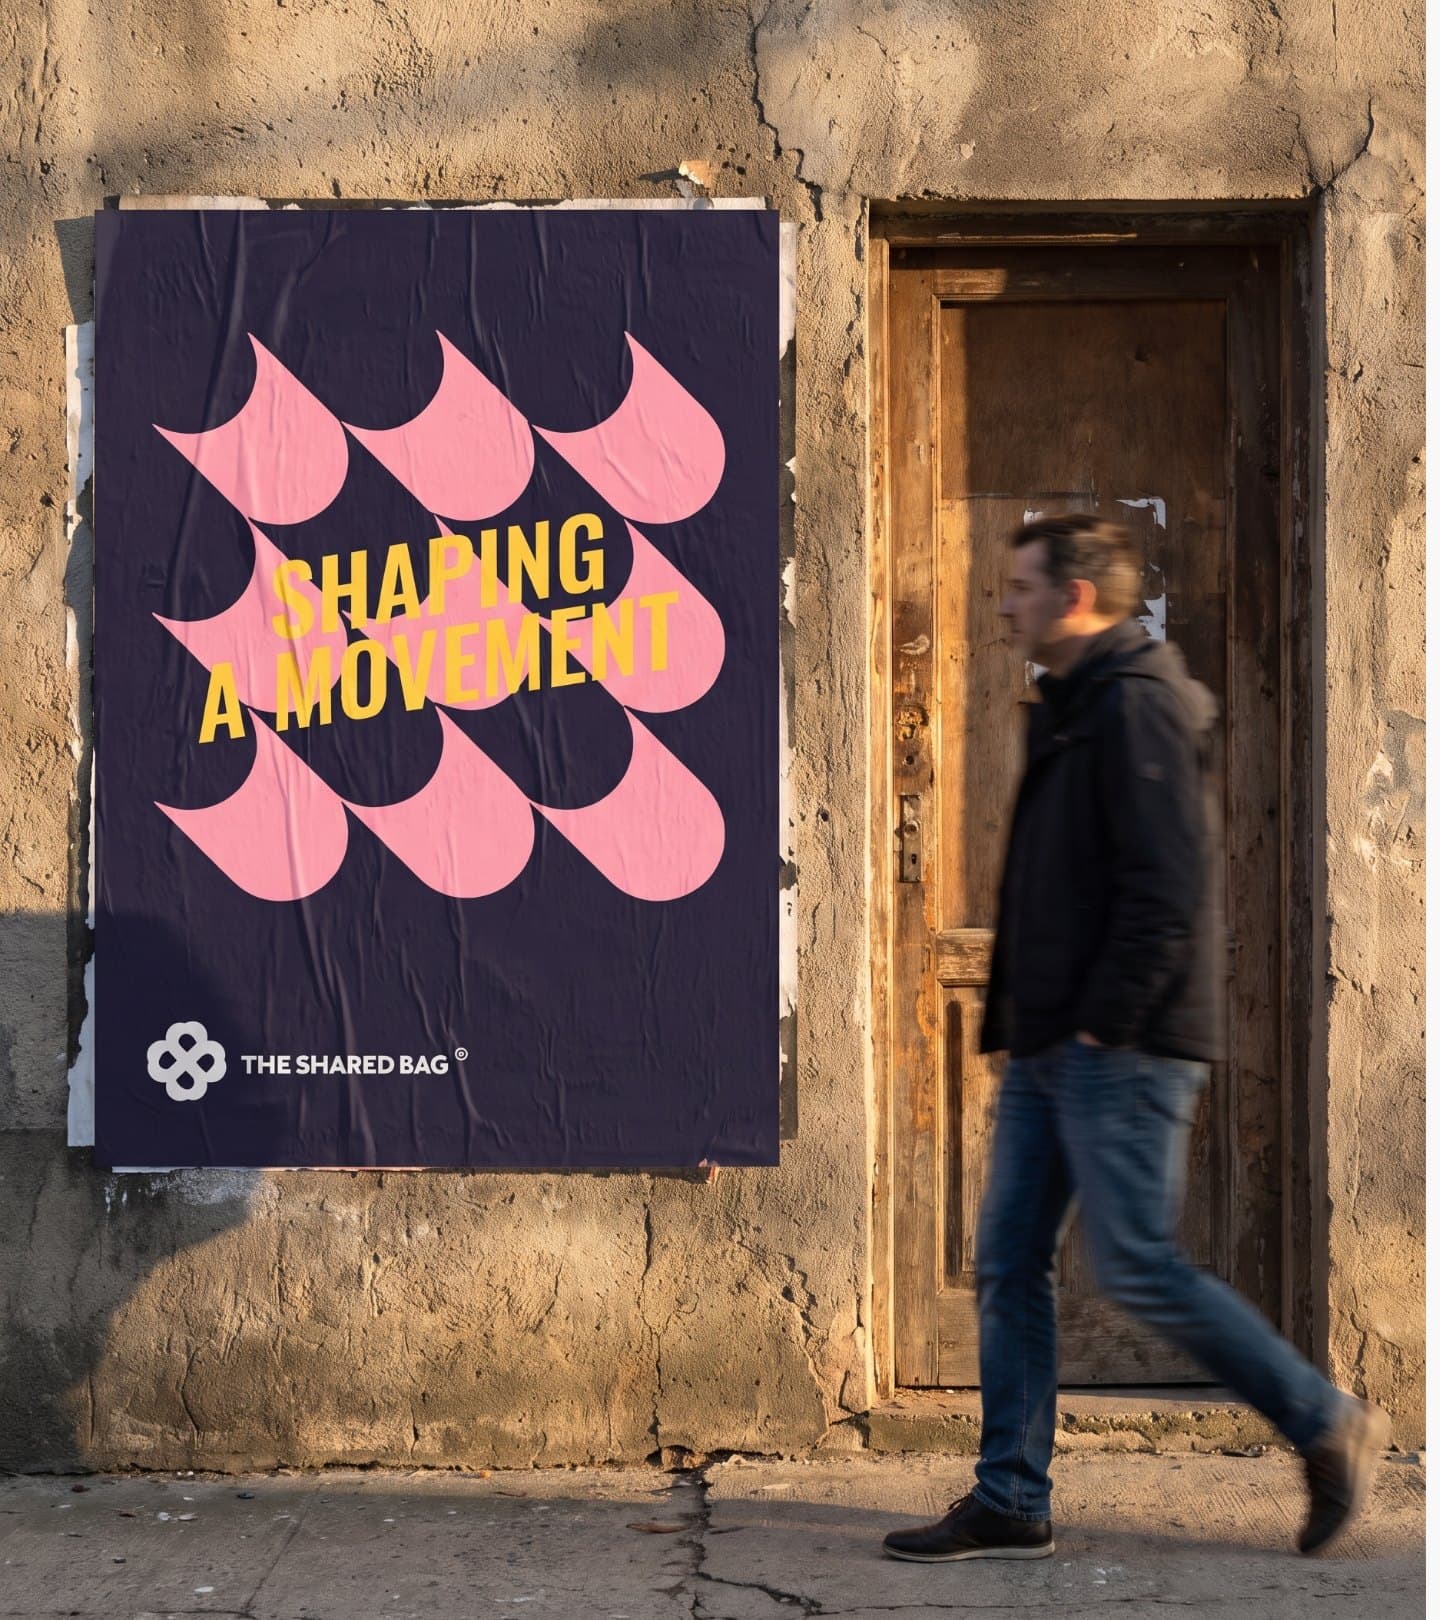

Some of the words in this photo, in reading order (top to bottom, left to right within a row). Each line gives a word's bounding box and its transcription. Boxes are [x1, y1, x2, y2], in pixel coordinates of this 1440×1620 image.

[272, 513, 604, 640] SHAPING
[199, 662, 245, 744] A
[275, 591, 679, 732] MOVEMENT
[240, 1055, 291, 1074] THE
[296, 1055, 395, 1074] SHARED
[400, 1055, 448, 1074] BAG
